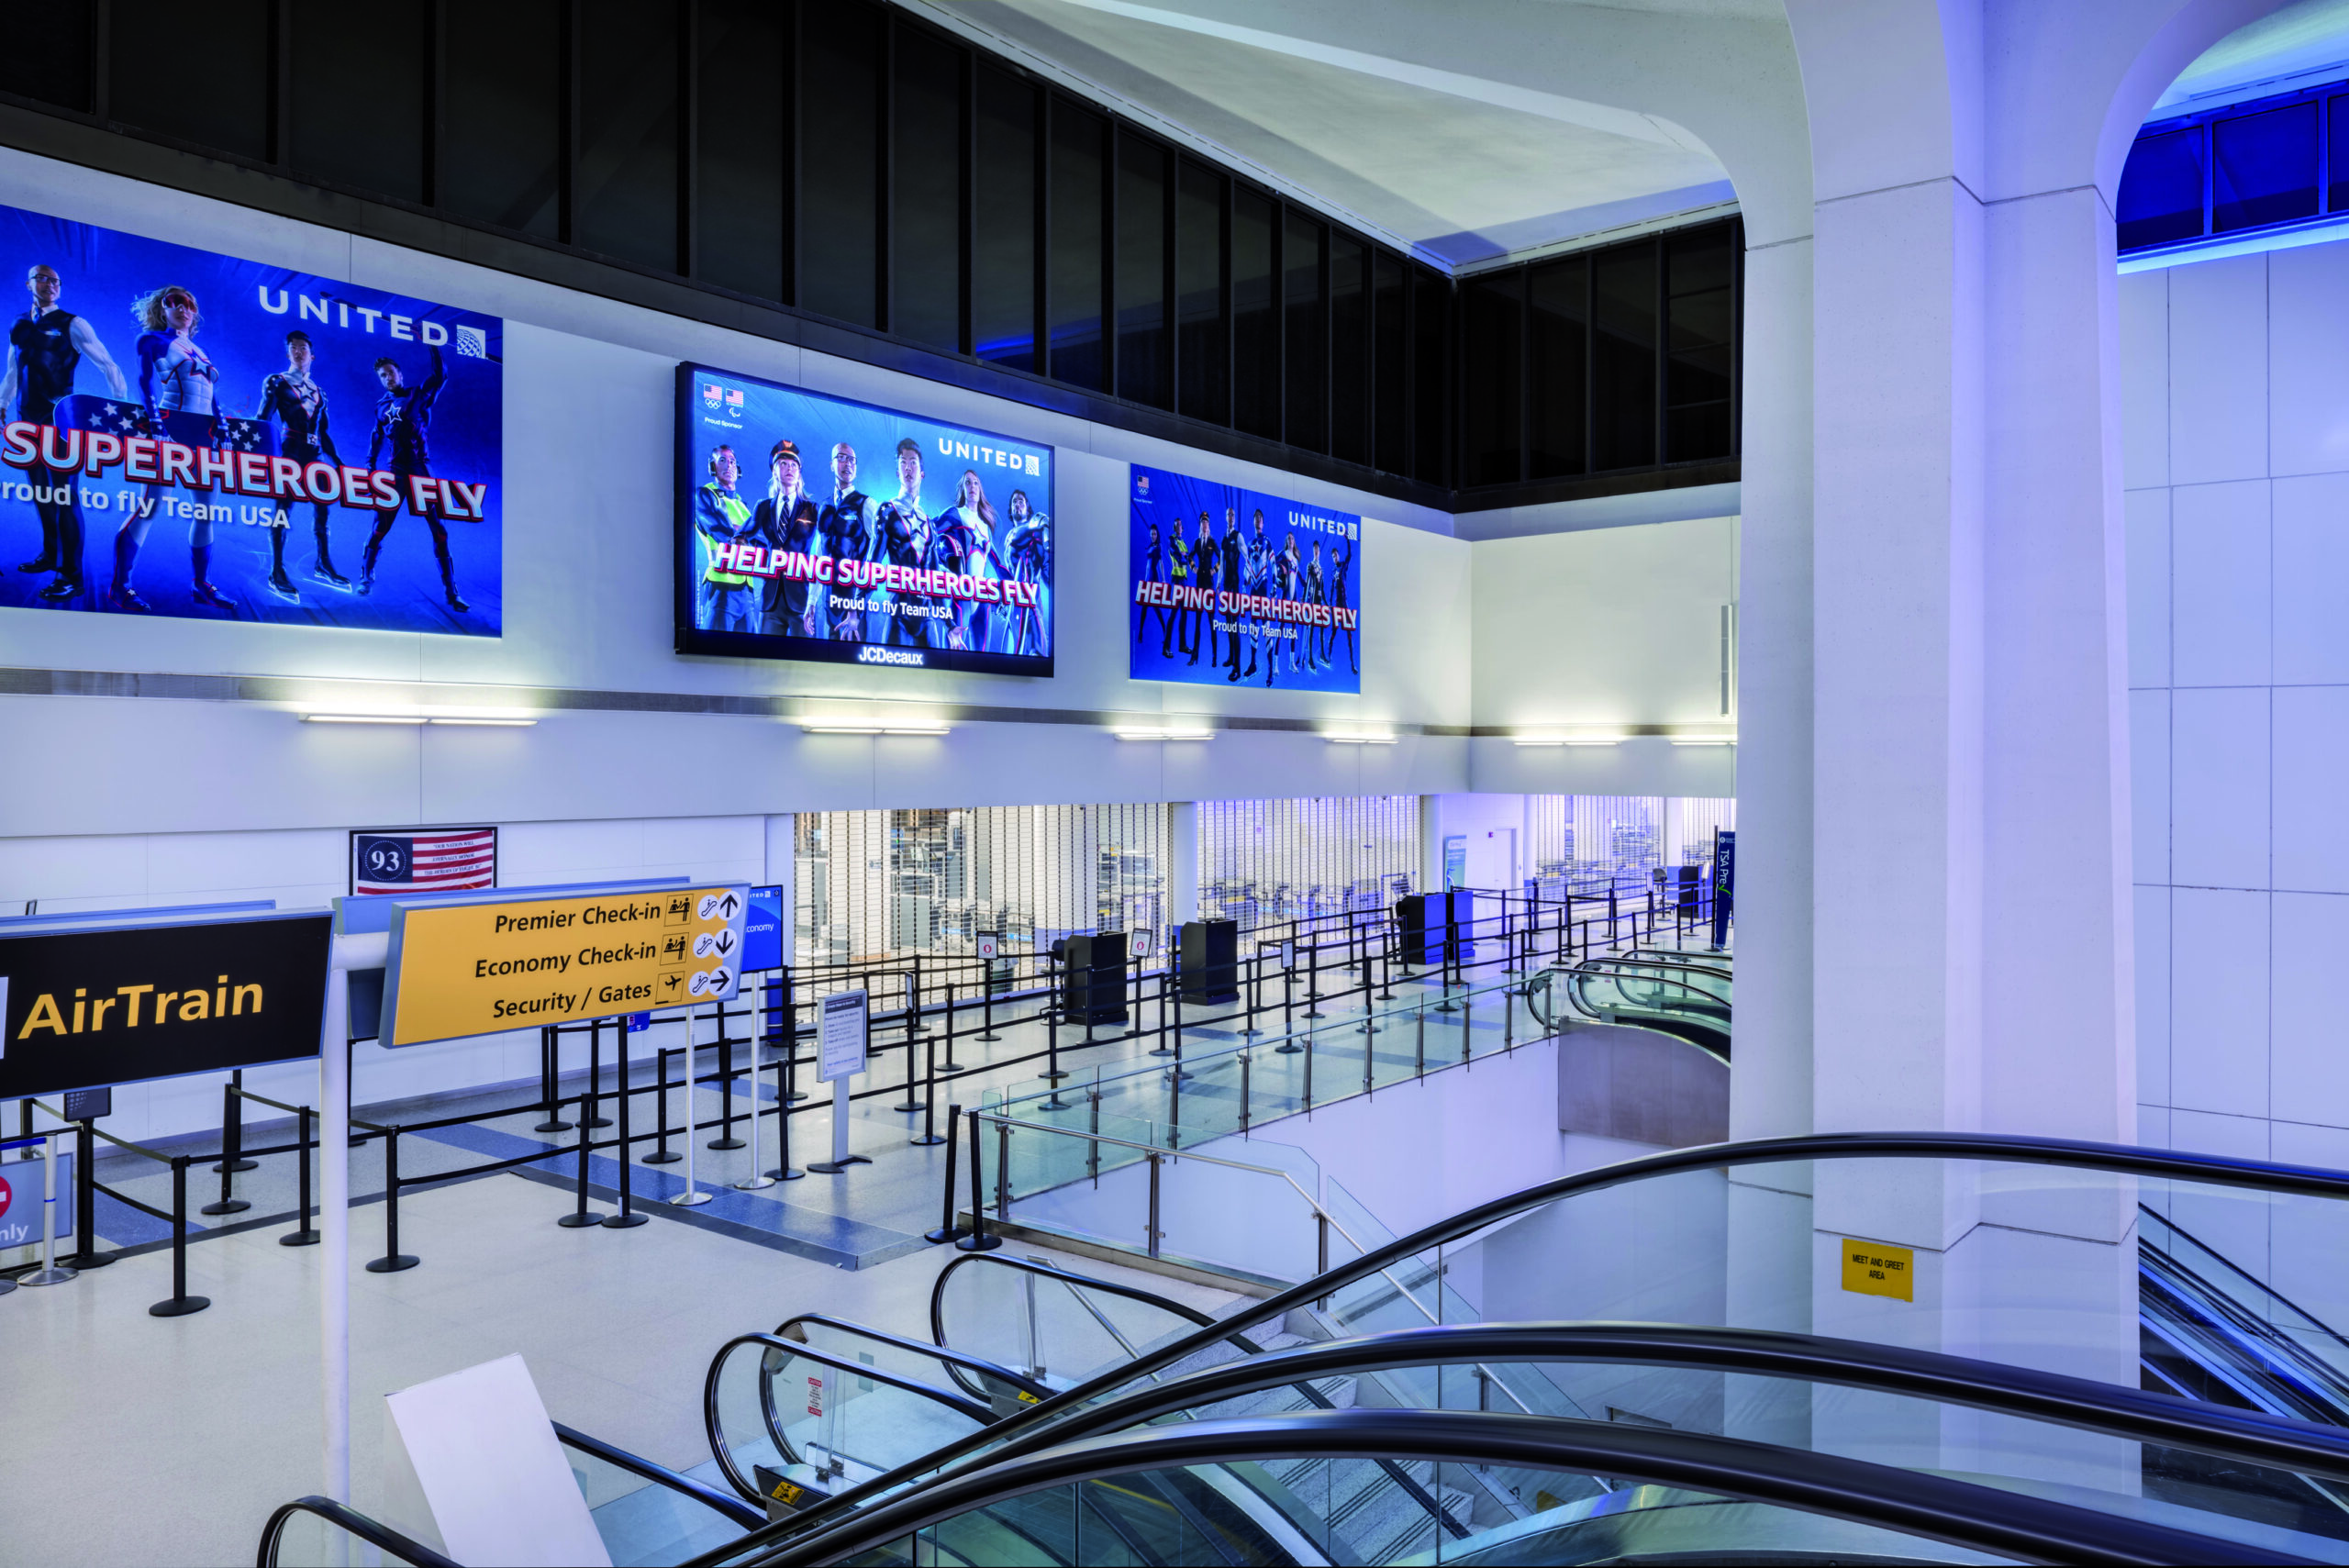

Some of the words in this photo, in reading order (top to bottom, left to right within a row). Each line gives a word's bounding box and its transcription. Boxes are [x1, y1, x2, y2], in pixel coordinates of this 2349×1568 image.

[258, 284, 449, 346] UNITED
[939, 437, 1023, 470] UNITED
[1, 420, 403, 512] SUPERHEROES
[408, 473, 487, 522] FLY
[0, 480, 72, 506] roud
[80, 486, 109, 509] to
[117, 490, 155, 517] fly
[161, 495, 233, 523] Team
[239, 505, 291, 529] USA
[1289, 511, 1346, 536] UNITED
[714, 541, 834, 584] HELPING
[837, 559, 1001, 604] SUPERHEROES
[1003, 579, 1039, 608] FLY
[829, 595, 865, 611] Proud
[867, 598, 880, 613] to
[882, 599, 897, 617] fly
[900, 602, 930, 617] Team
[931, 606, 954, 620] USA
[1135, 580, 1216, 612] HELPING
[1218, 591, 1330, 627] SUPERHEROES
[1332, 606, 1357, 631] FLY
[1213, 619, 1238, 633] Proud
[1239, 622, 1247, 634] to
[1248, 623, 1260, 637] fly
[1261, 625, 1282, 638] Team
[1283, 628, 1298, 639] USA
[858, 645, 924, 666] JCDecaux
[371, 851, 400, 872] 93
[1720, 849, 1730, 866] TSA
[1720, 868, 1728, 884] Pre
[494, 907, 577, 934] Premier
[582, 902, 662, 926] Check-in
[746, 923, 774, 932] conomy
[474, 951, 572, 980] Economy
[577, 941, 657, 967] Check-in
[17, 974, 263, 1040] AirTrain
[493, 992, 577, 1019] Security
[580, 986, 593, 1011] /
[597, 982, 652, 1005] Gates
[0, 1223, 28, 1242] nly
[1852, 1254, 1868, 1264] MEET
[1870, 1257, 1884, 1268] AND
[1885, 1260, 1904, 1270] GREET
[1869, 1270, 1885, 1280] AREA
